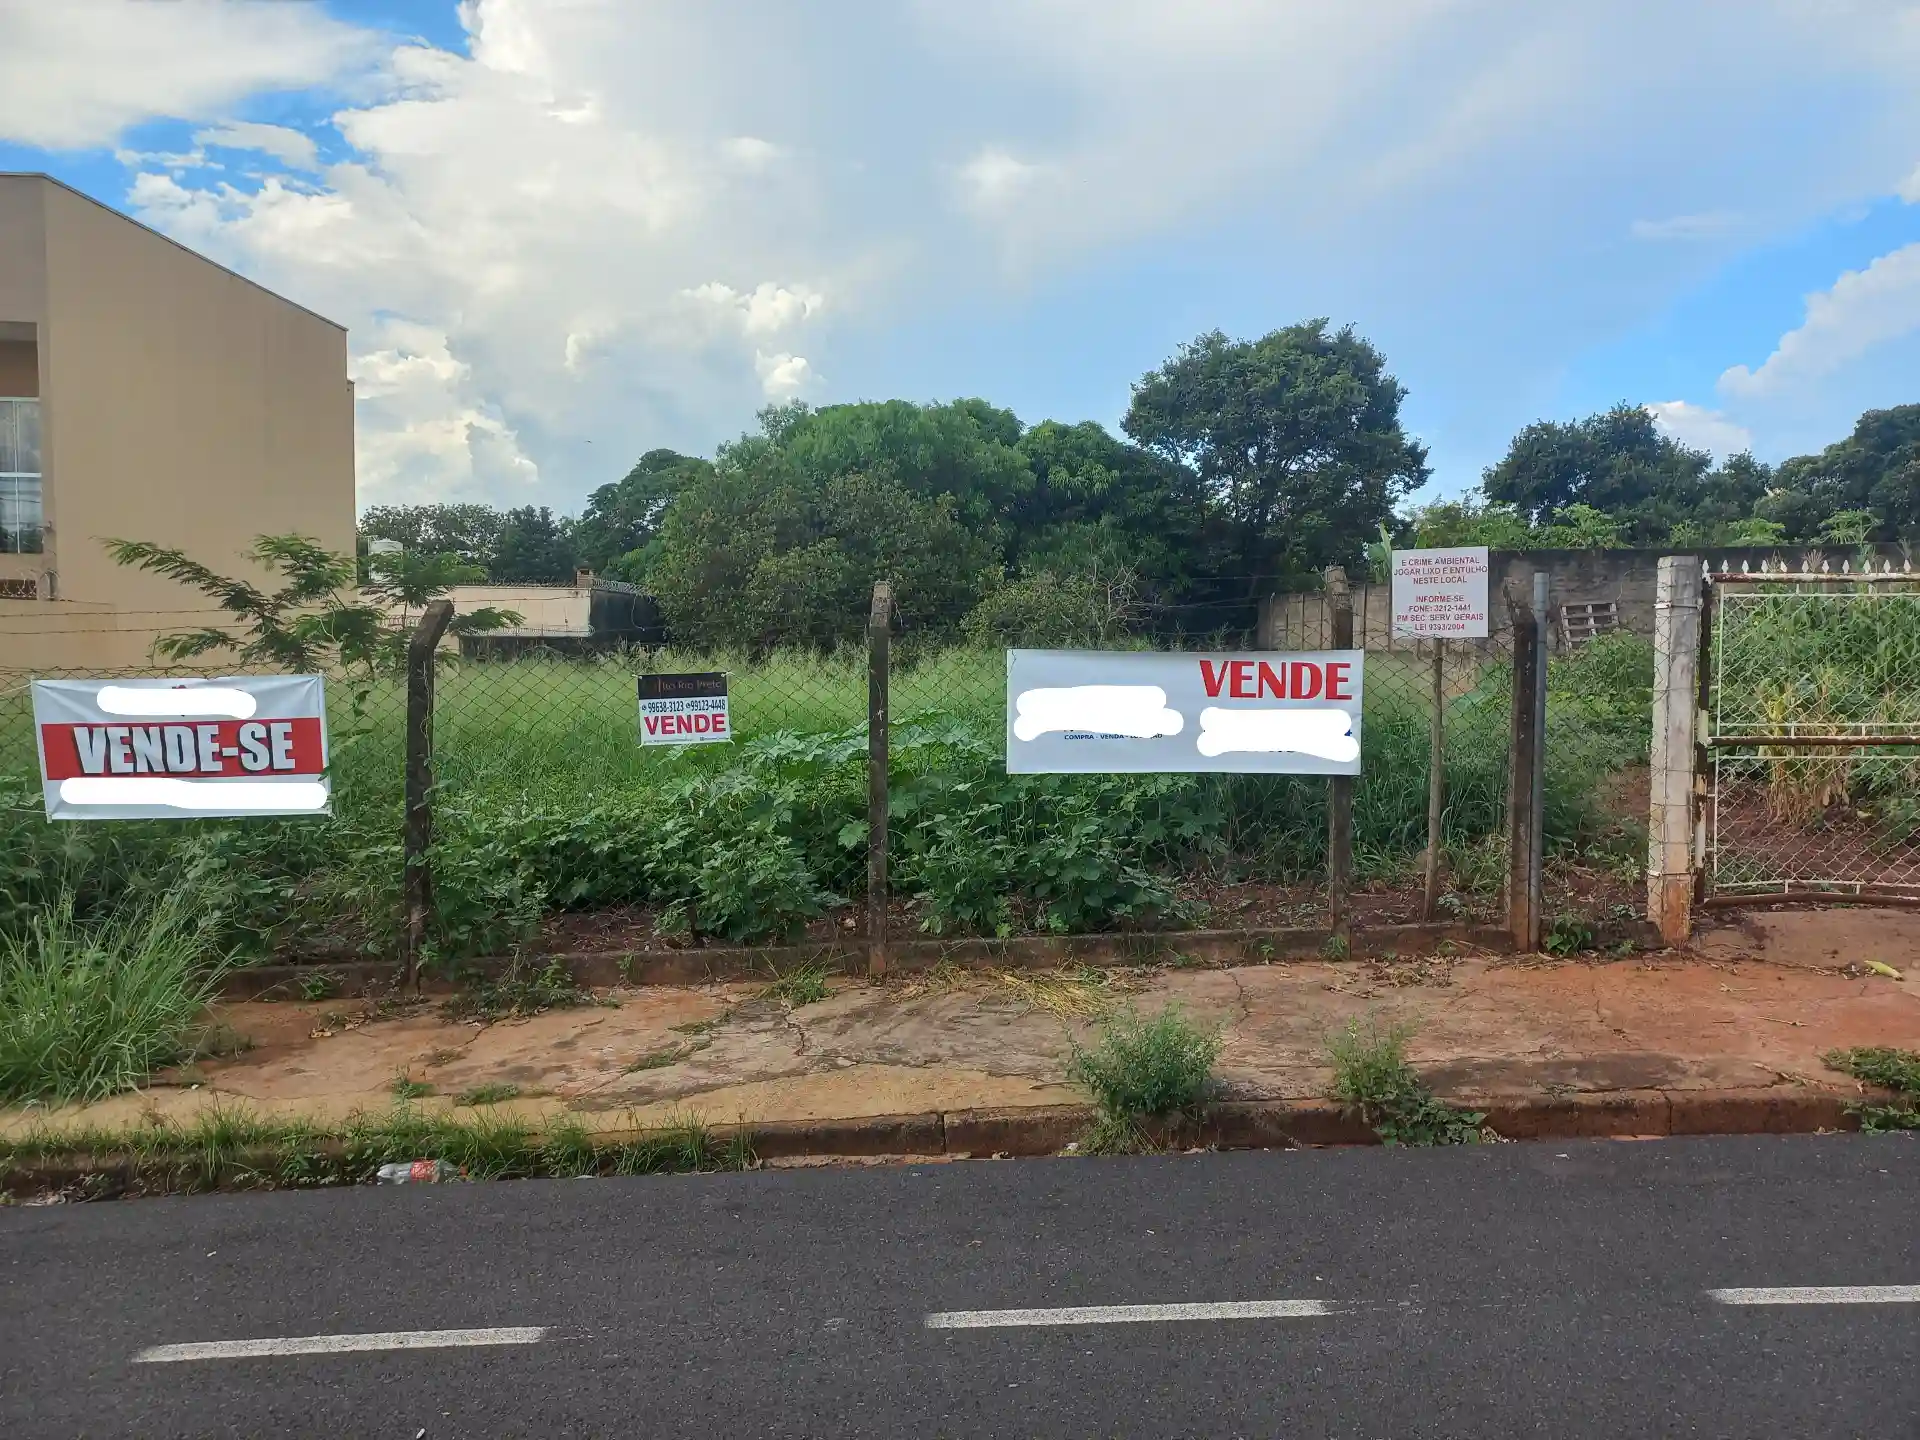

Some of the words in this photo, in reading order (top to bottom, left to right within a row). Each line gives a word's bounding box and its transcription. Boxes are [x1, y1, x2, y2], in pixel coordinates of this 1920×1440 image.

[1408, 558, 1433, 566] CRIME
[1434, 556, 1480, 565] AMBIENTAL
[1394, 568, 1421, 576] JOGAR
[1422, 567, 1441, 575] LIXO
[1450, 565, 1488, 574] ENTULHO
[1413, 577, 1439, 585] NESTE
[1440, 576, 1468, 584] LOCAL
[1415, 595, 1465, 603] INFORME-SE
[1408, 605, 1433, 613] FONE:
[1434, 604, 1471, 612] 3212-1441
[1396, 614, 1408, 622] PM
[1453, 613, 1484, 621] GERAIS
[1414, 623, 1427, 631] LEI
[1199, 659, 1353, 701] VENDE
[647, 701, 684, 713] 99638-3123
[643, 713, 727, 735] VENDE
[73, 721, 297, 775] VENDE-SE
